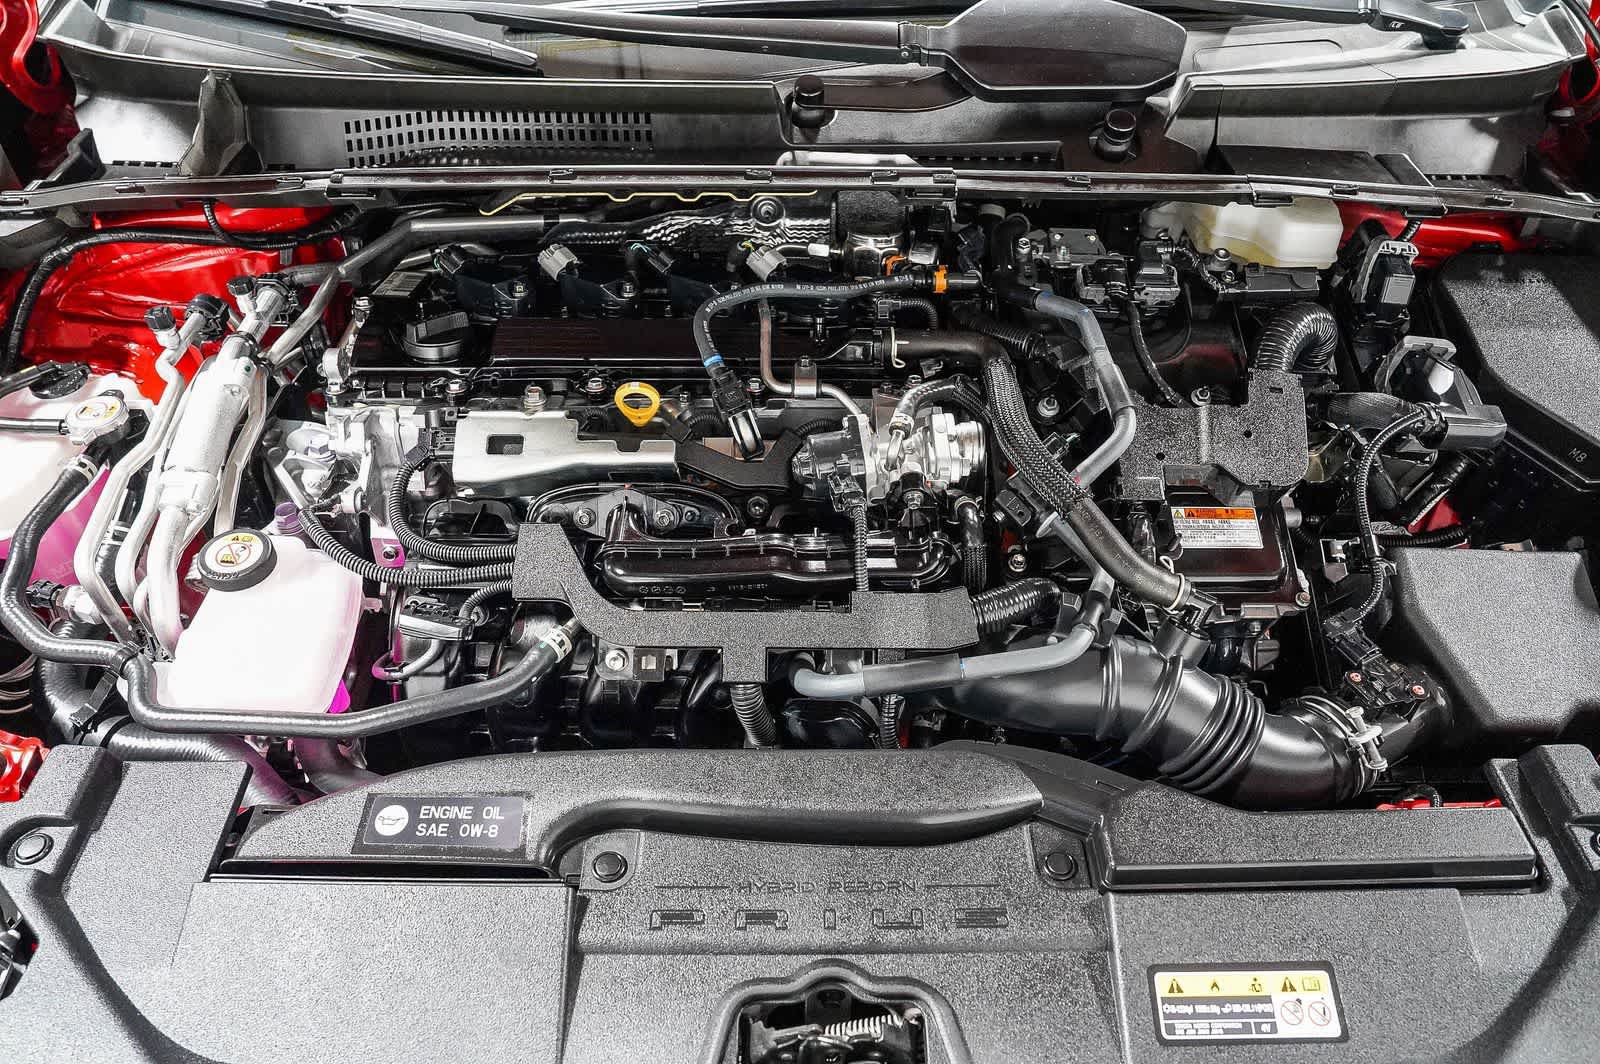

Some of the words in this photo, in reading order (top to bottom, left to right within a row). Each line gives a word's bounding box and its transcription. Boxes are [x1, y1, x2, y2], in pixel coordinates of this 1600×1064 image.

[419, 805, 474, 820] ENGINE
[482, 806, 505, 820] OIL
[415, 823, 450, 837] SAE
[459, 824, 499, 838] 0W-8
[739, 881, 815, 894] HYBRID
[829, 880, 916, 893] REBORN
[650, 908, 1009, 930] PRIUS
